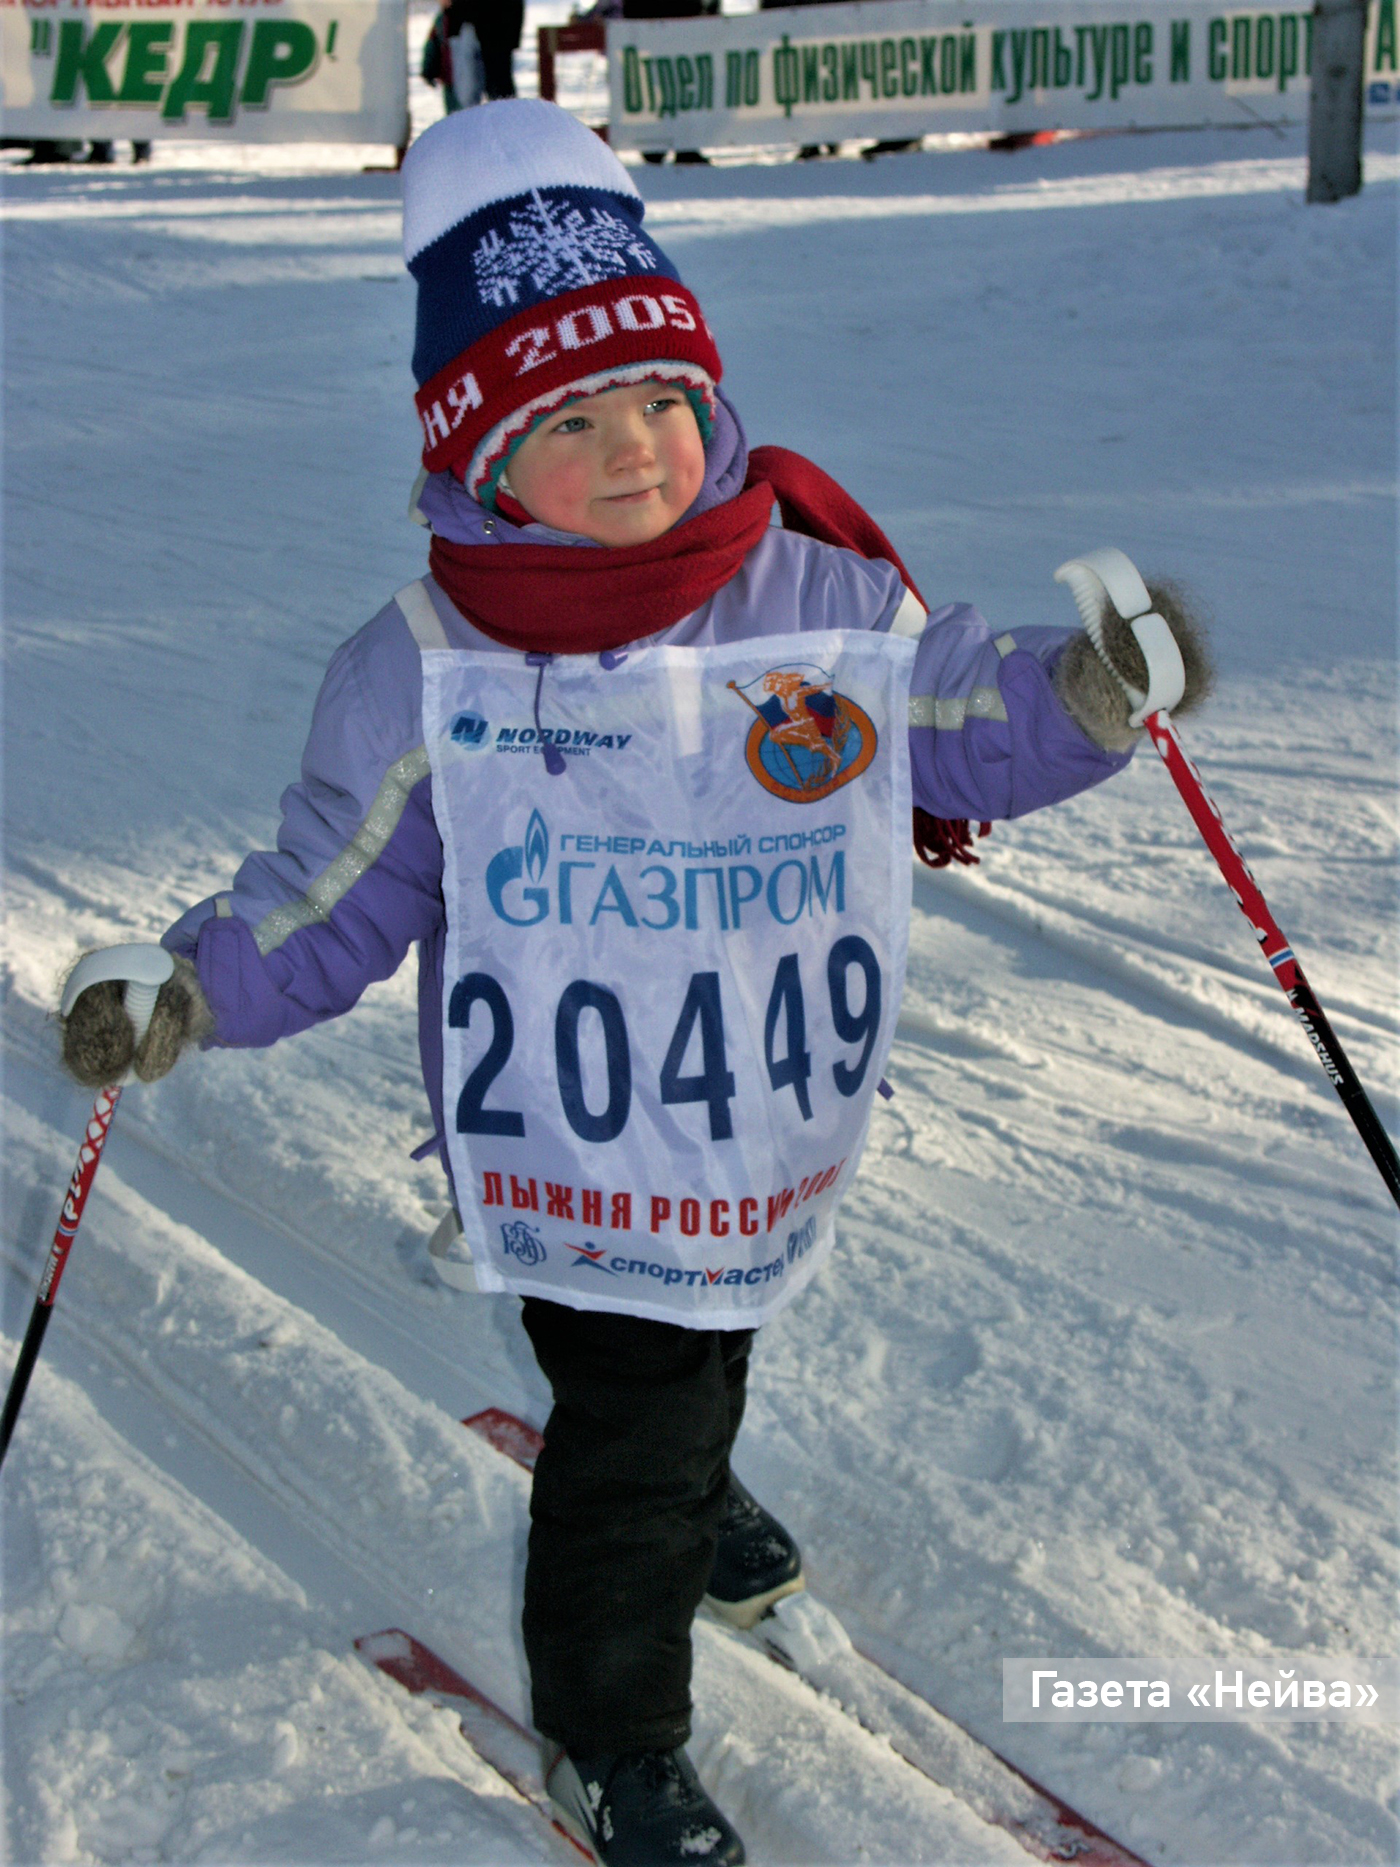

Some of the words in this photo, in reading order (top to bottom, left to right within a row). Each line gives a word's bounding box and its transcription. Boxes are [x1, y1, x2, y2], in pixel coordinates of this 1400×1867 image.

[622, 45, 714, 119] Отдел
[726, 49, 760, 107] по
[772, 21, 977, 118] физической
[990, 21, 1153, 103] культуре
[1170, 19, 1190, 82] и
[1208, 12, 1314, 91] спорт
[425, 372, 483, 452] НЯ
[505, 295, 697, 376] 2005
[496, 728, 632, 750] NORDWAY
[496, 744, 531, 754] SPORT
[534, 746, 591, 756] EPMENT
[560, 833, 751, 858] ГЕНЕРАЛЬНЫЙ
[758, 824, 846, 854] СПОНСОР
[558, 850, 846, 931] ГАЗПРОМ
[448, 935, 882, 1143] 20449
[483, 1171, 632, 1230] ЛЫЖНЯ
